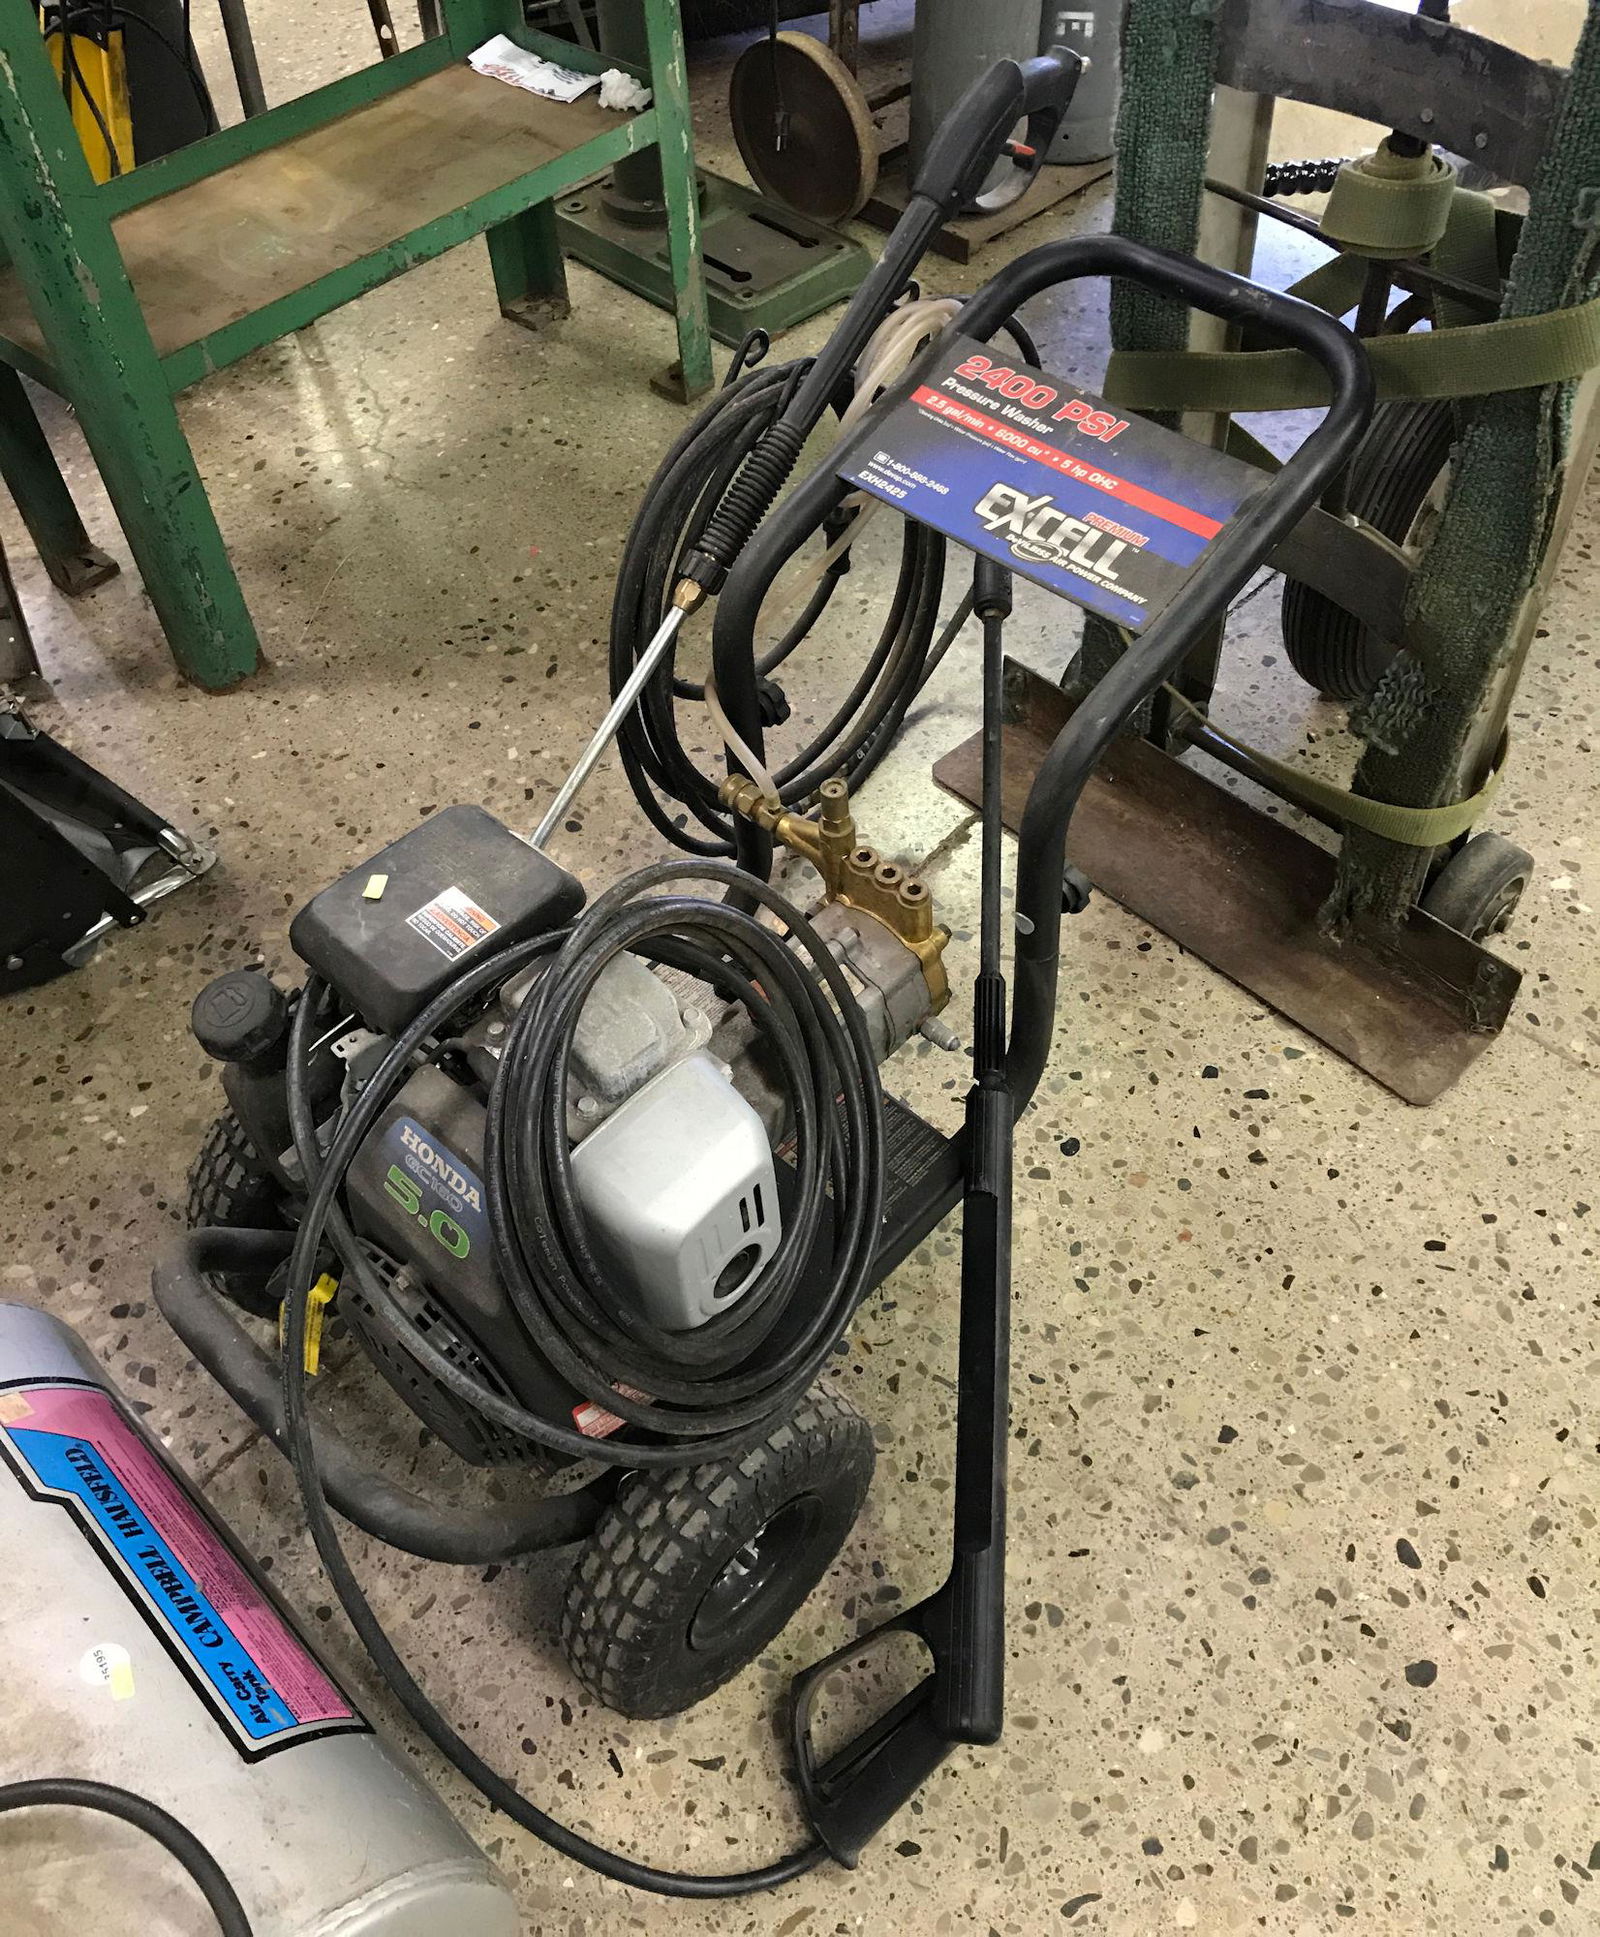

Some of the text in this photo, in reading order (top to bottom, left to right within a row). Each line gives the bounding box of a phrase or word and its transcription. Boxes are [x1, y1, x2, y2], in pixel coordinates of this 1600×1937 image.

[926, 394, 943, 410] 2.5
[943, 403, 985, 430] gal/min
[994, 428, 1029, 450] 6000
[1059, 459, 1072, 471] 5
[1071, 463, 1087, 478] hp
[1088, 471, 1119, 489] OHC
[941, 377, 1054, 435] Pressure Washer
[953, 355, 1131, 444] 2400 PSI
[858, 470, 908, 500] EXH2425
[1082, 511, 1150, 547] PREMIUM
[974, 482, 1127, 581] EXCELL
[1049, 554, 1068, 568] AIR
[1065, 561, 1105, 588] POWER
[1099, 579, 1149, 606] COMPANY
[383, 1164, 471, 1259] 5.0
[399, 1125, 482, 1213] HONDA
[64, 1446, 144, 1539] HAUSFELD
[136, 1544, 224, 1647] CAMPBELL
[218, 1660, 270, 1725] Air Carry
[240, 1668, 271, 1704] Tank
